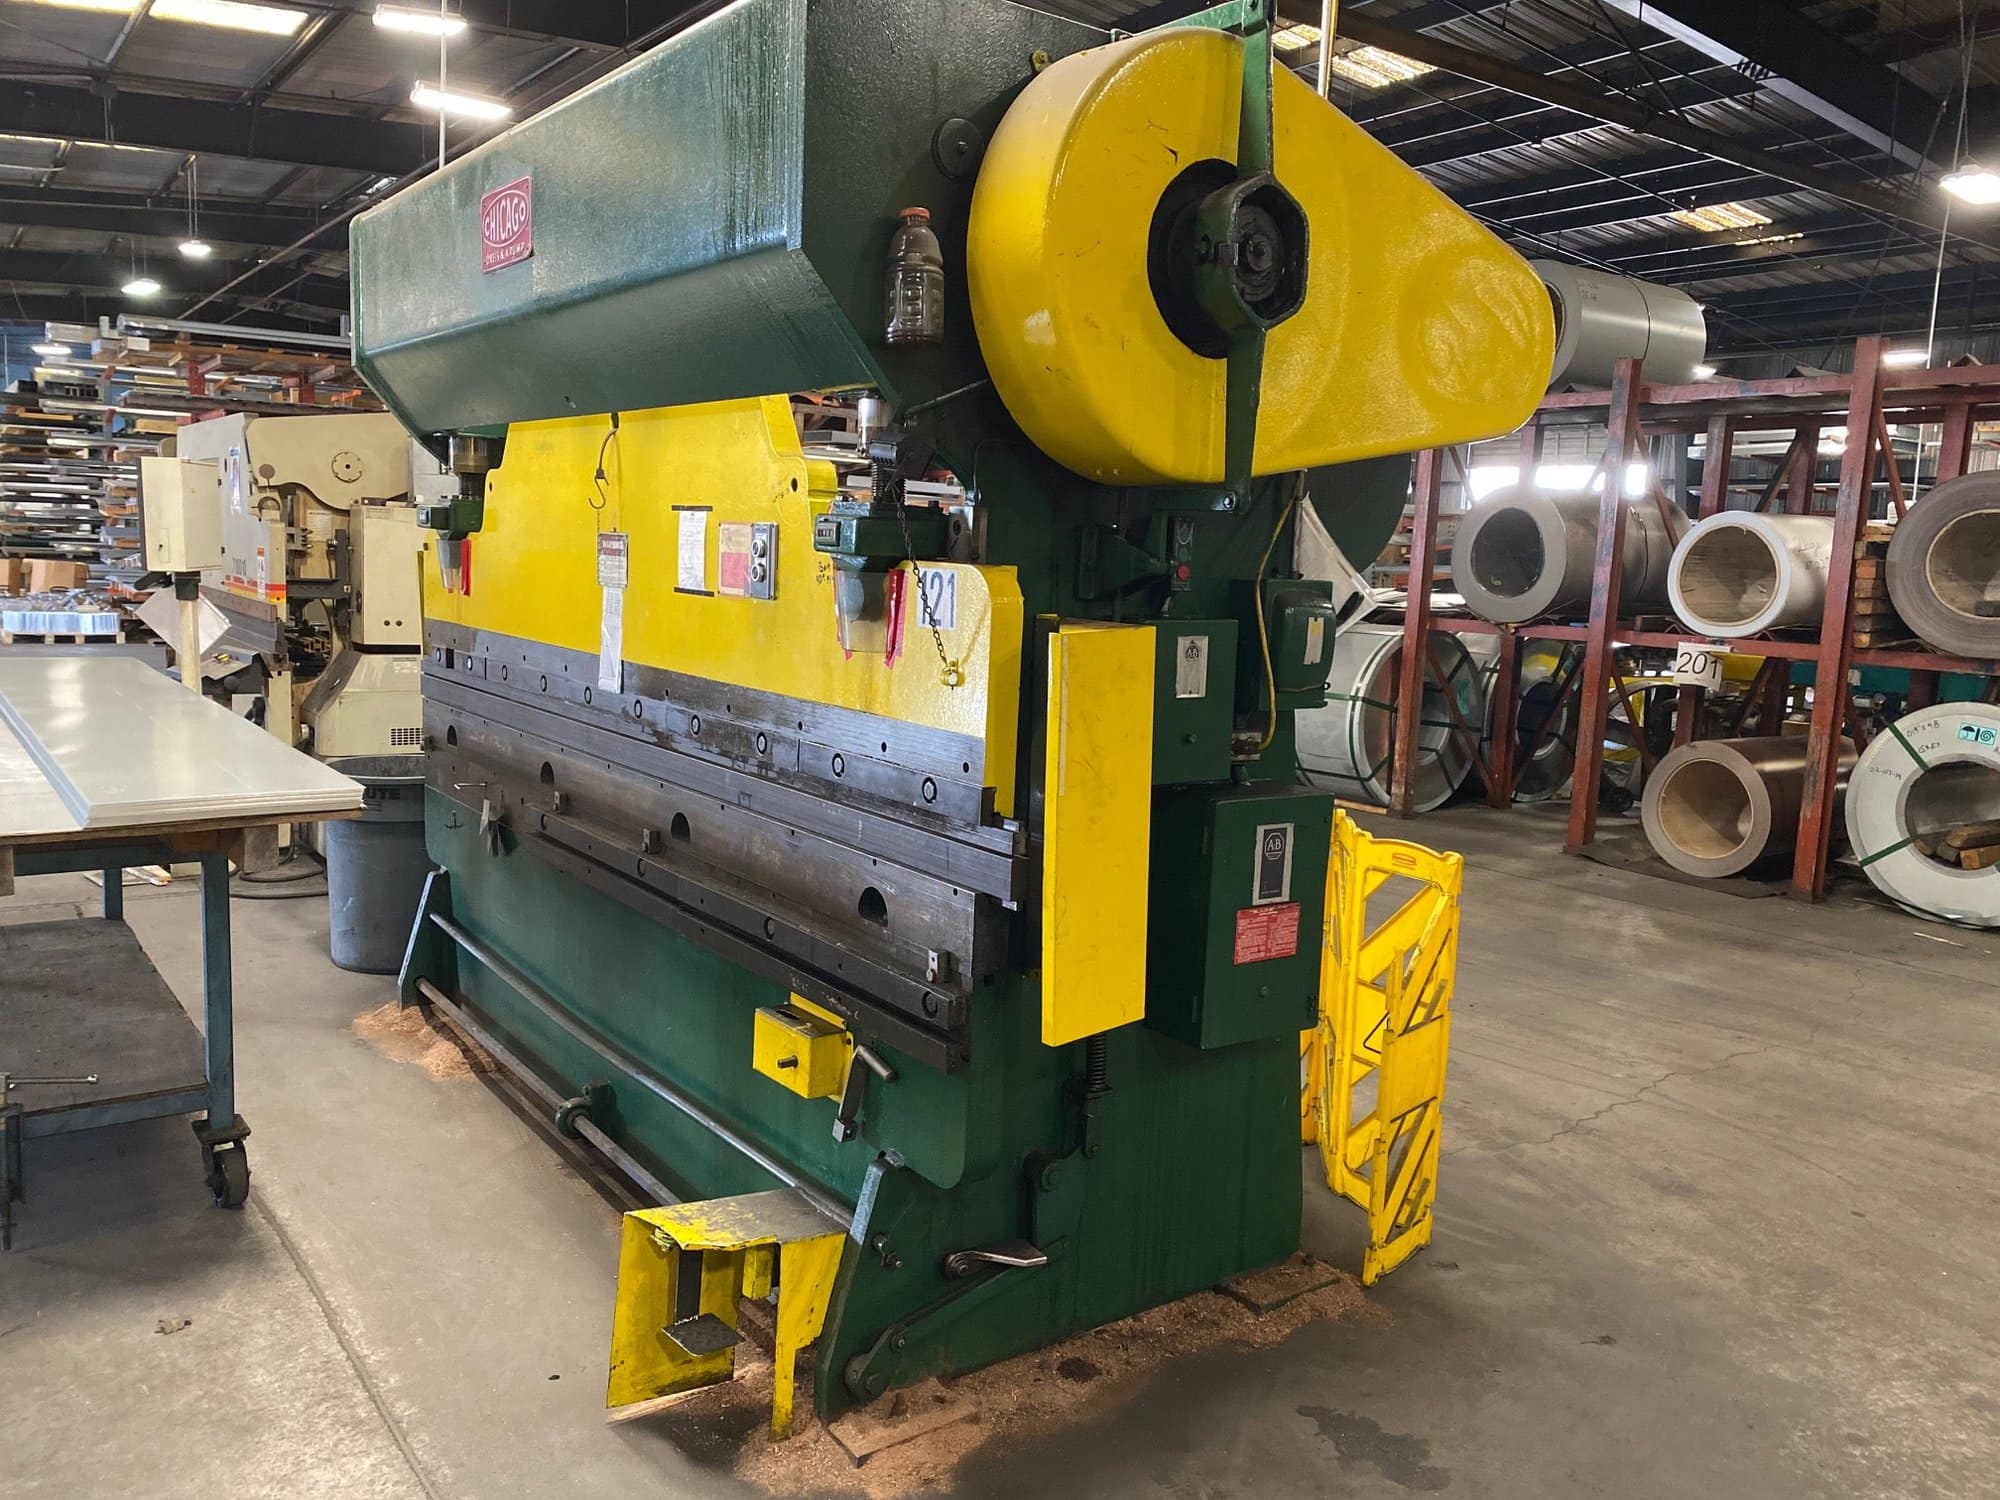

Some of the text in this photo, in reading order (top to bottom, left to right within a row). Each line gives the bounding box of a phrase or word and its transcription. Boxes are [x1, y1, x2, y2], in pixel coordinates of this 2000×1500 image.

[484, 196, 526, 241] CHICAGO
[921, 570, 955, 628] 121
[1677, 652, 1718, 680] 201
[366, 787, 401, 801] UTE
